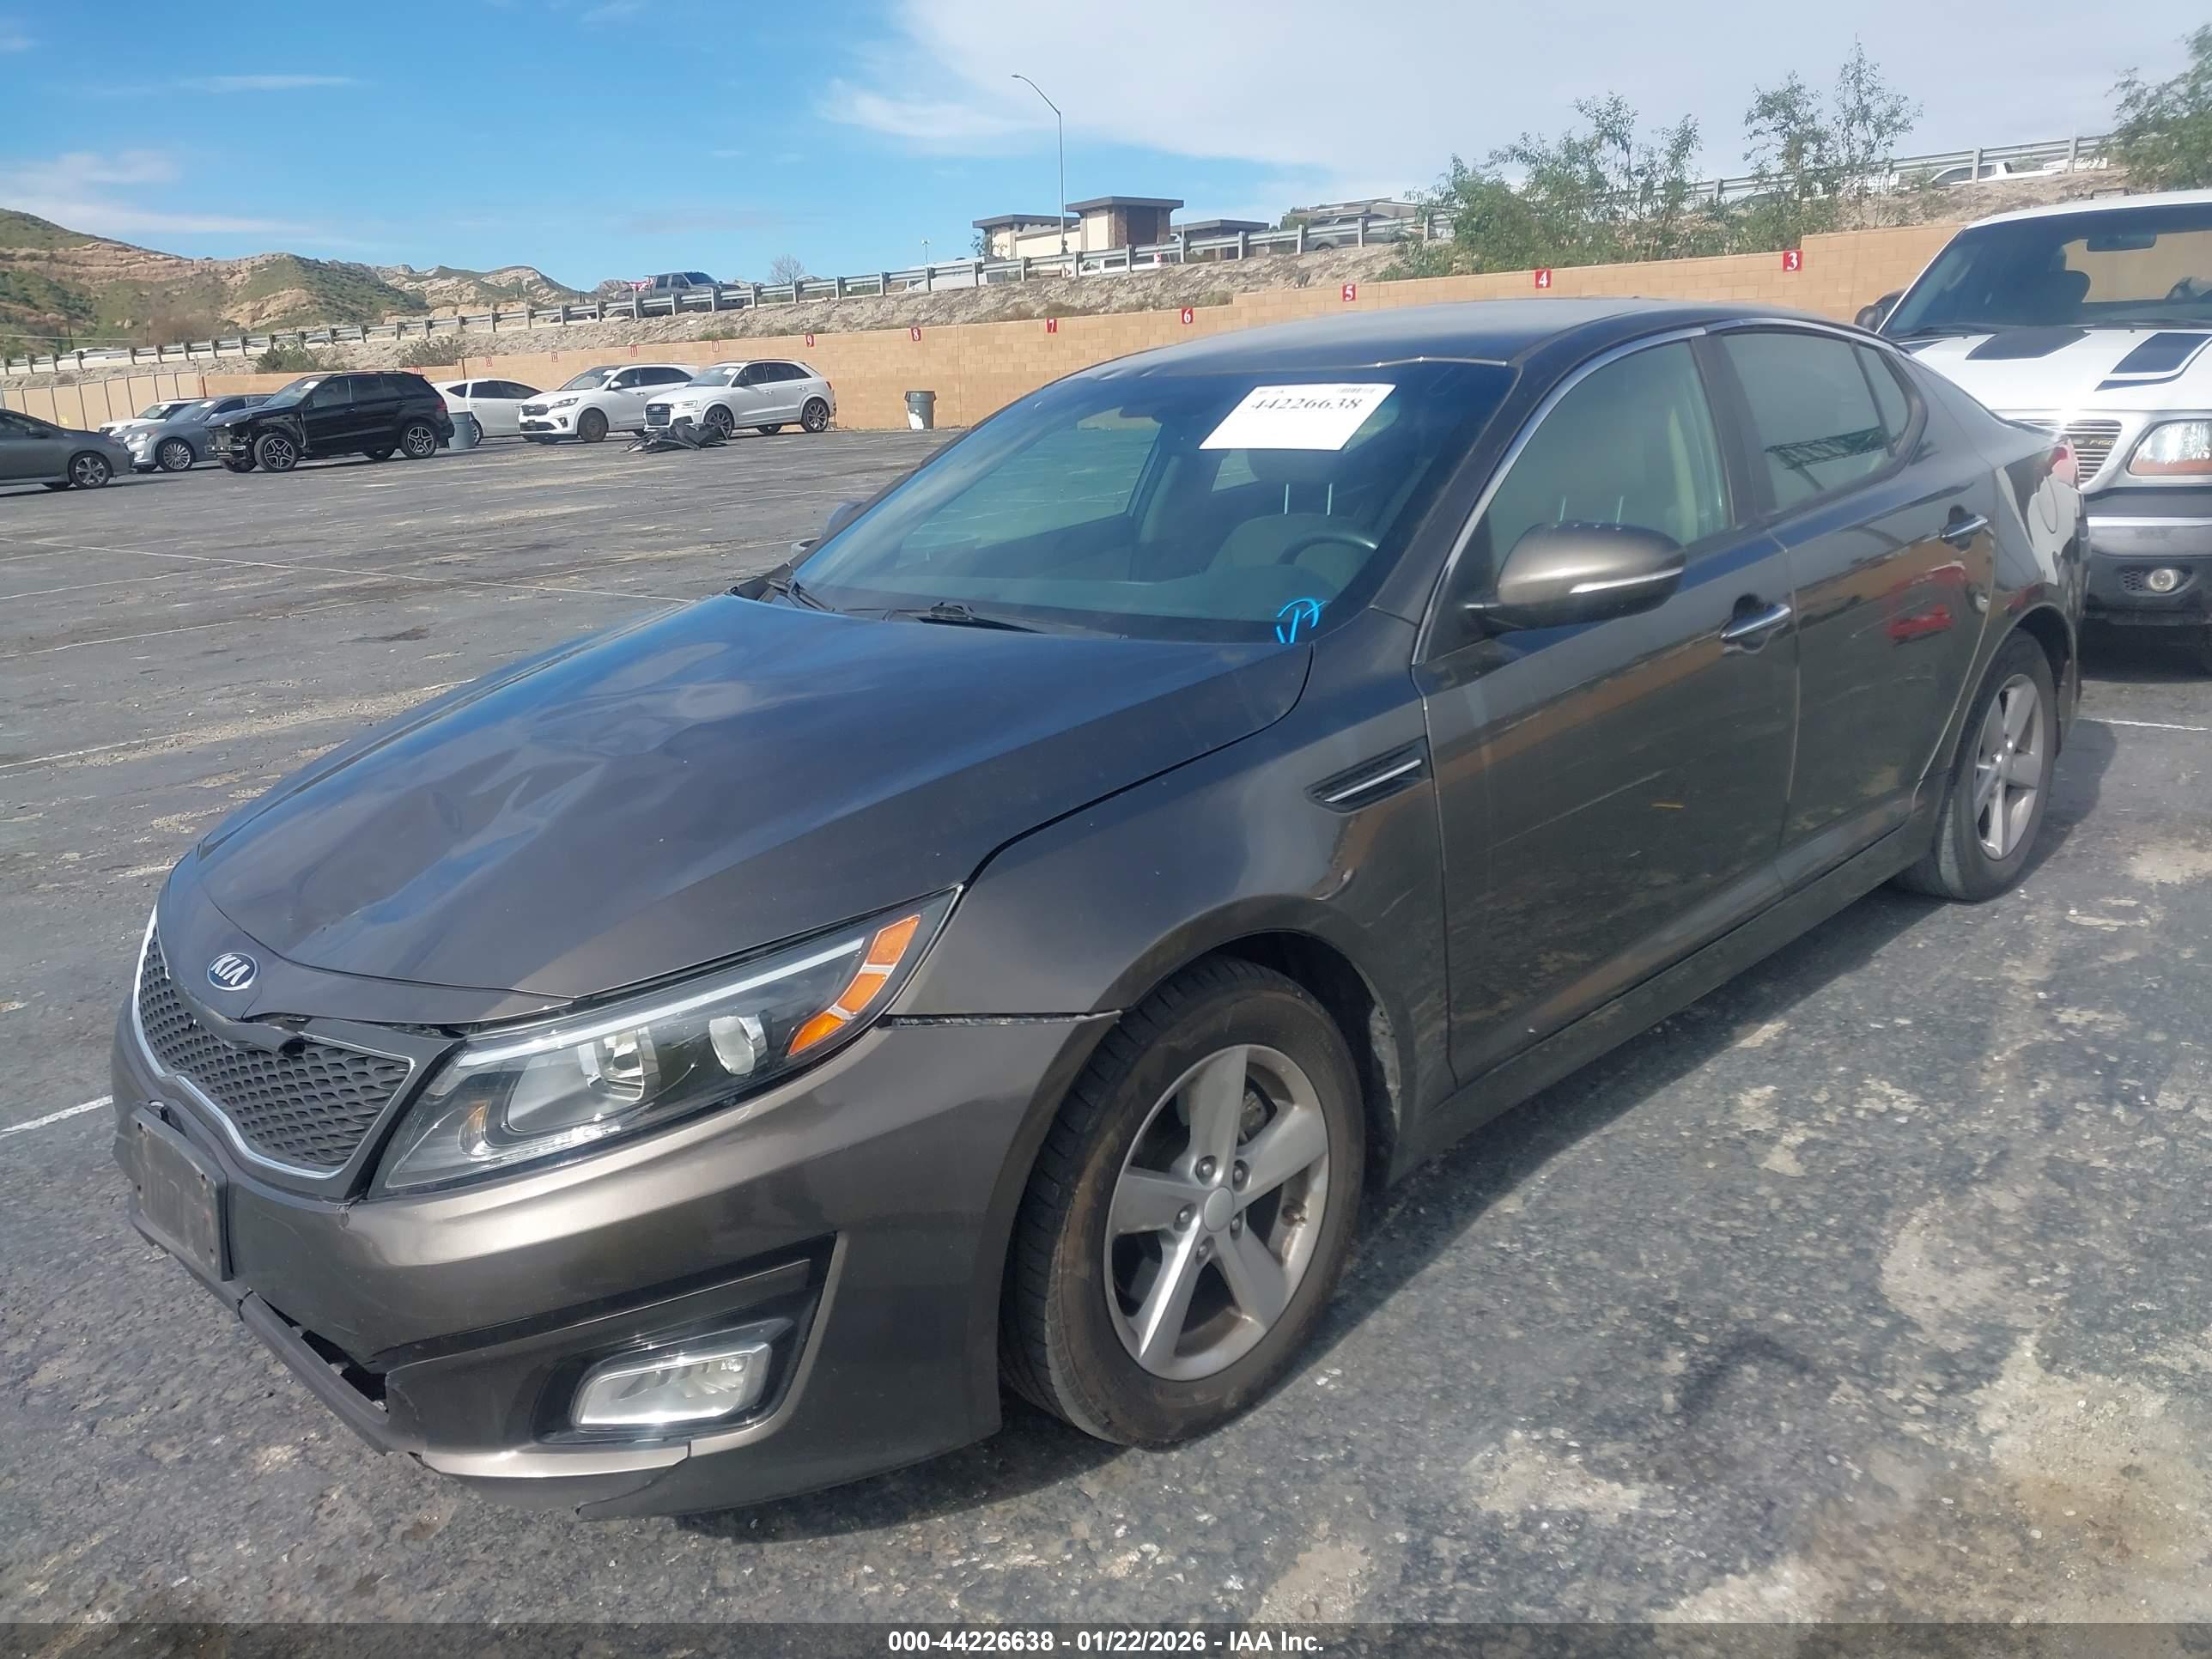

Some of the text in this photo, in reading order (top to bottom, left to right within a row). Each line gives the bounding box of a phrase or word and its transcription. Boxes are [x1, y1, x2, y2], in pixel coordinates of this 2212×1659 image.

[1786, 252, 1798, 270] 3
[1538, 270, 1548, 288] 4
[1345, 285, 1353, 301] 5
[1183, 308, 1191, 324] 6
[1048, 319, 1054, 332] 7
[913, 328, 920, 341] 8
[210, 954, 250, 986] KIA
